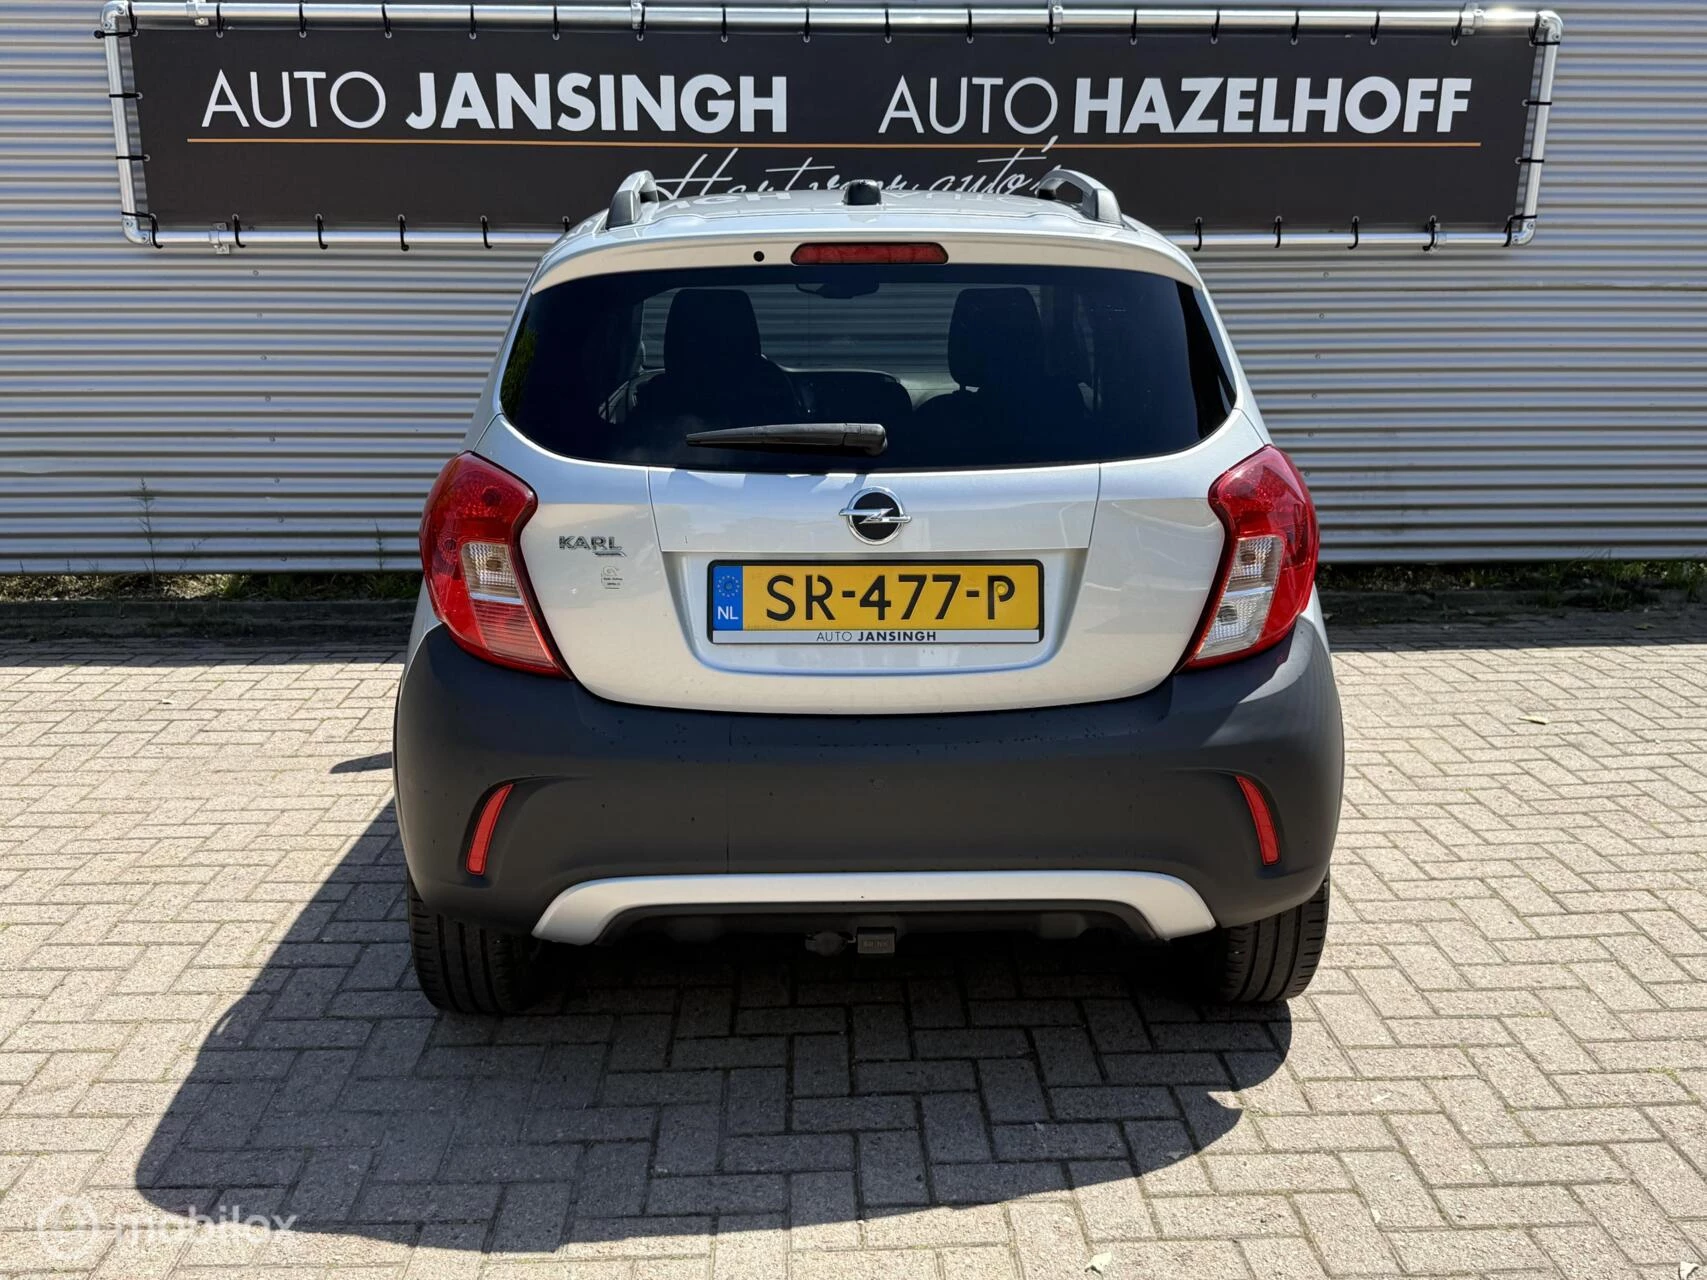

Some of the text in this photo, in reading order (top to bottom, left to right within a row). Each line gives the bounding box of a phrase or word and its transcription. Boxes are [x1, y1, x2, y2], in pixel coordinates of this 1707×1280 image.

[201, 69, 788, 134] AUTO JANSINGH
[878, 75, 1473, 135] AUTO HAZELHOFF
[558, 535, 623, 550] KARL
[717, 606, 739, 620] NL
[765, 574, 1016, 622] SR-477-P
[816, 631, 936, 642] AUTO JANSINGH
